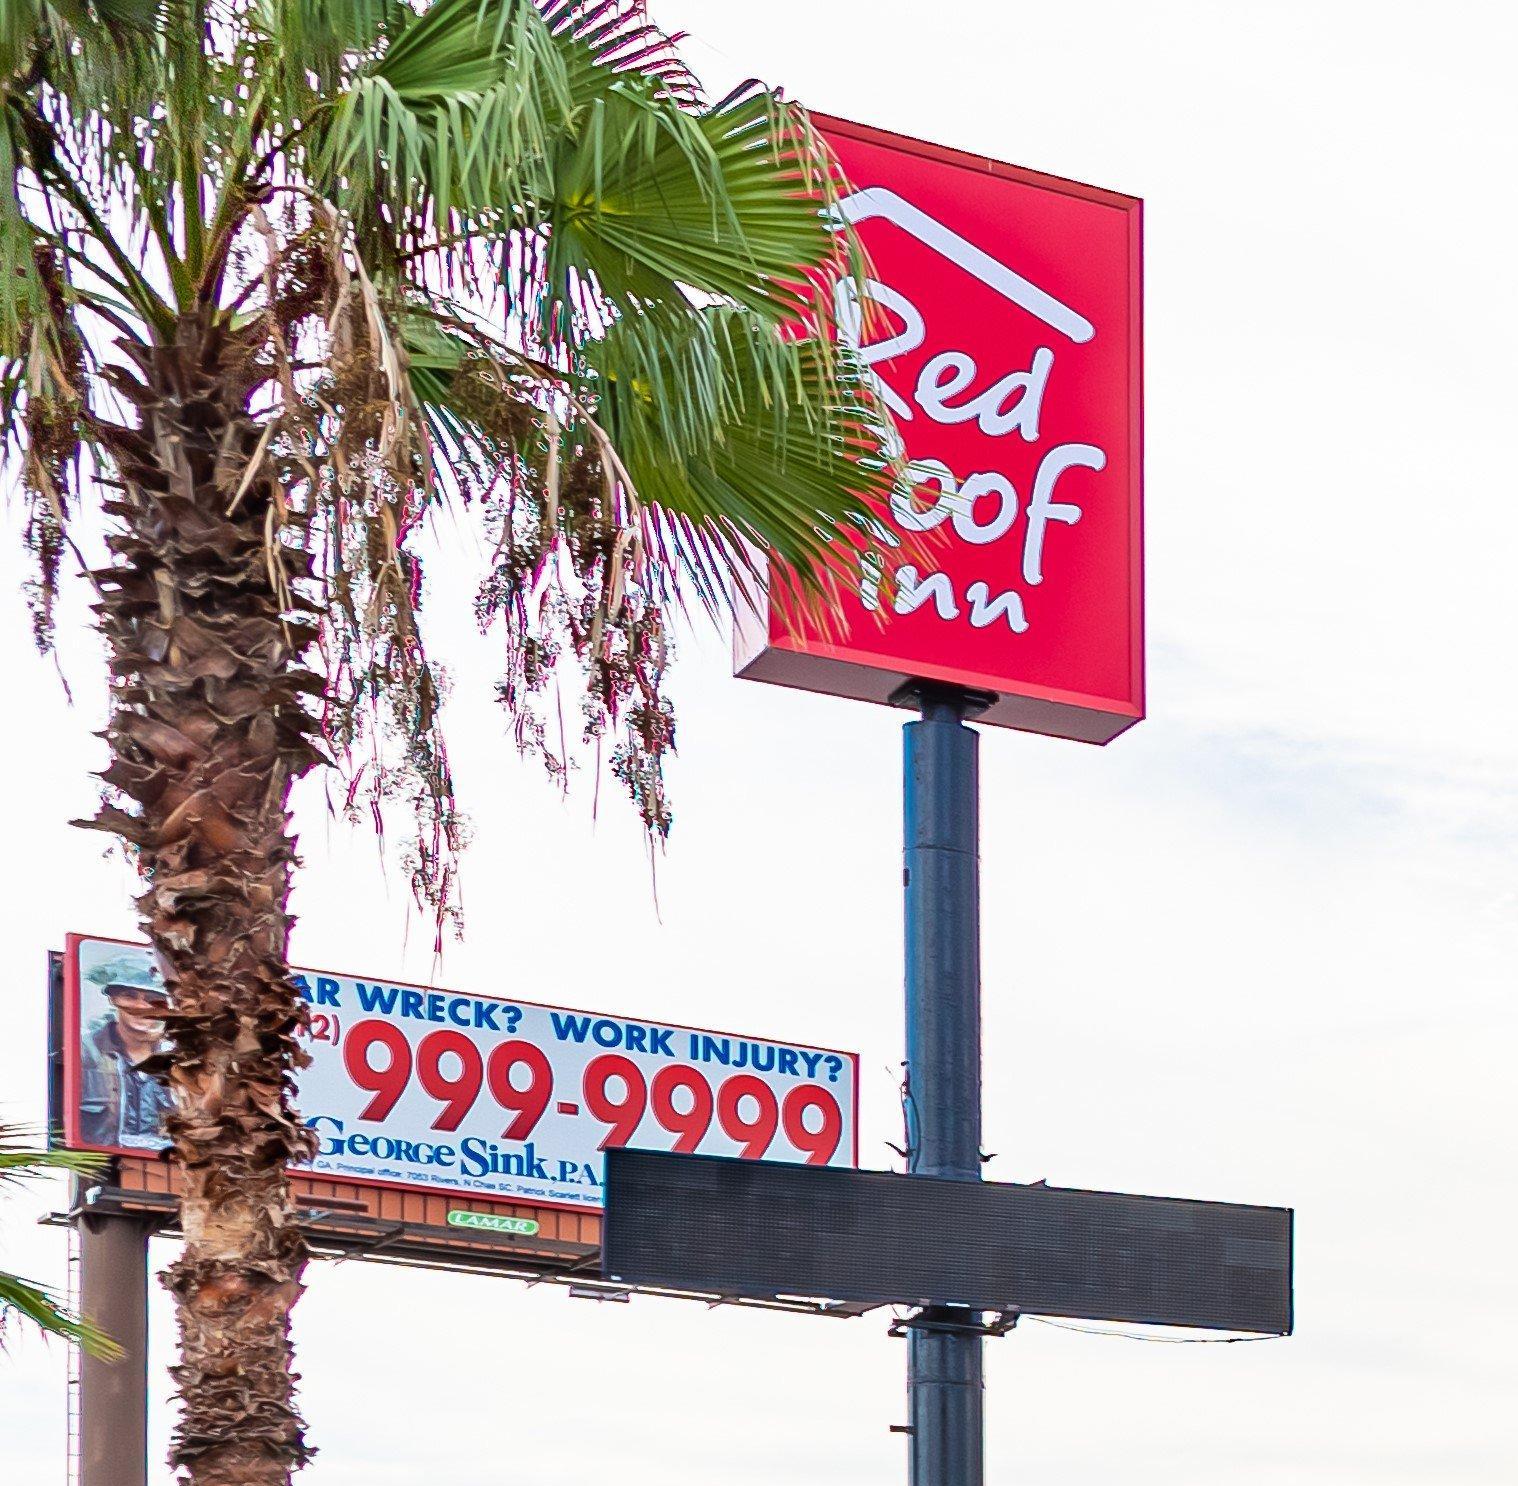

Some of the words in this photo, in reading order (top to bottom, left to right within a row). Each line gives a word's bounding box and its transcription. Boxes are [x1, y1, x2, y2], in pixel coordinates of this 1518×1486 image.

[834, 276, 1054, 442] Red
[862, 440, 1107, 585] oof
[293, 975, 341, 1007] AR
[356, 983, 522, 1033] WRECK?
[550, 1012, 675, 1057] WORK
[690, 1033, 843, 1084] INJURY?
[343, 1018, 842, 1168] 999-9999
[455, 1213, 528, 1232] LAMAR
